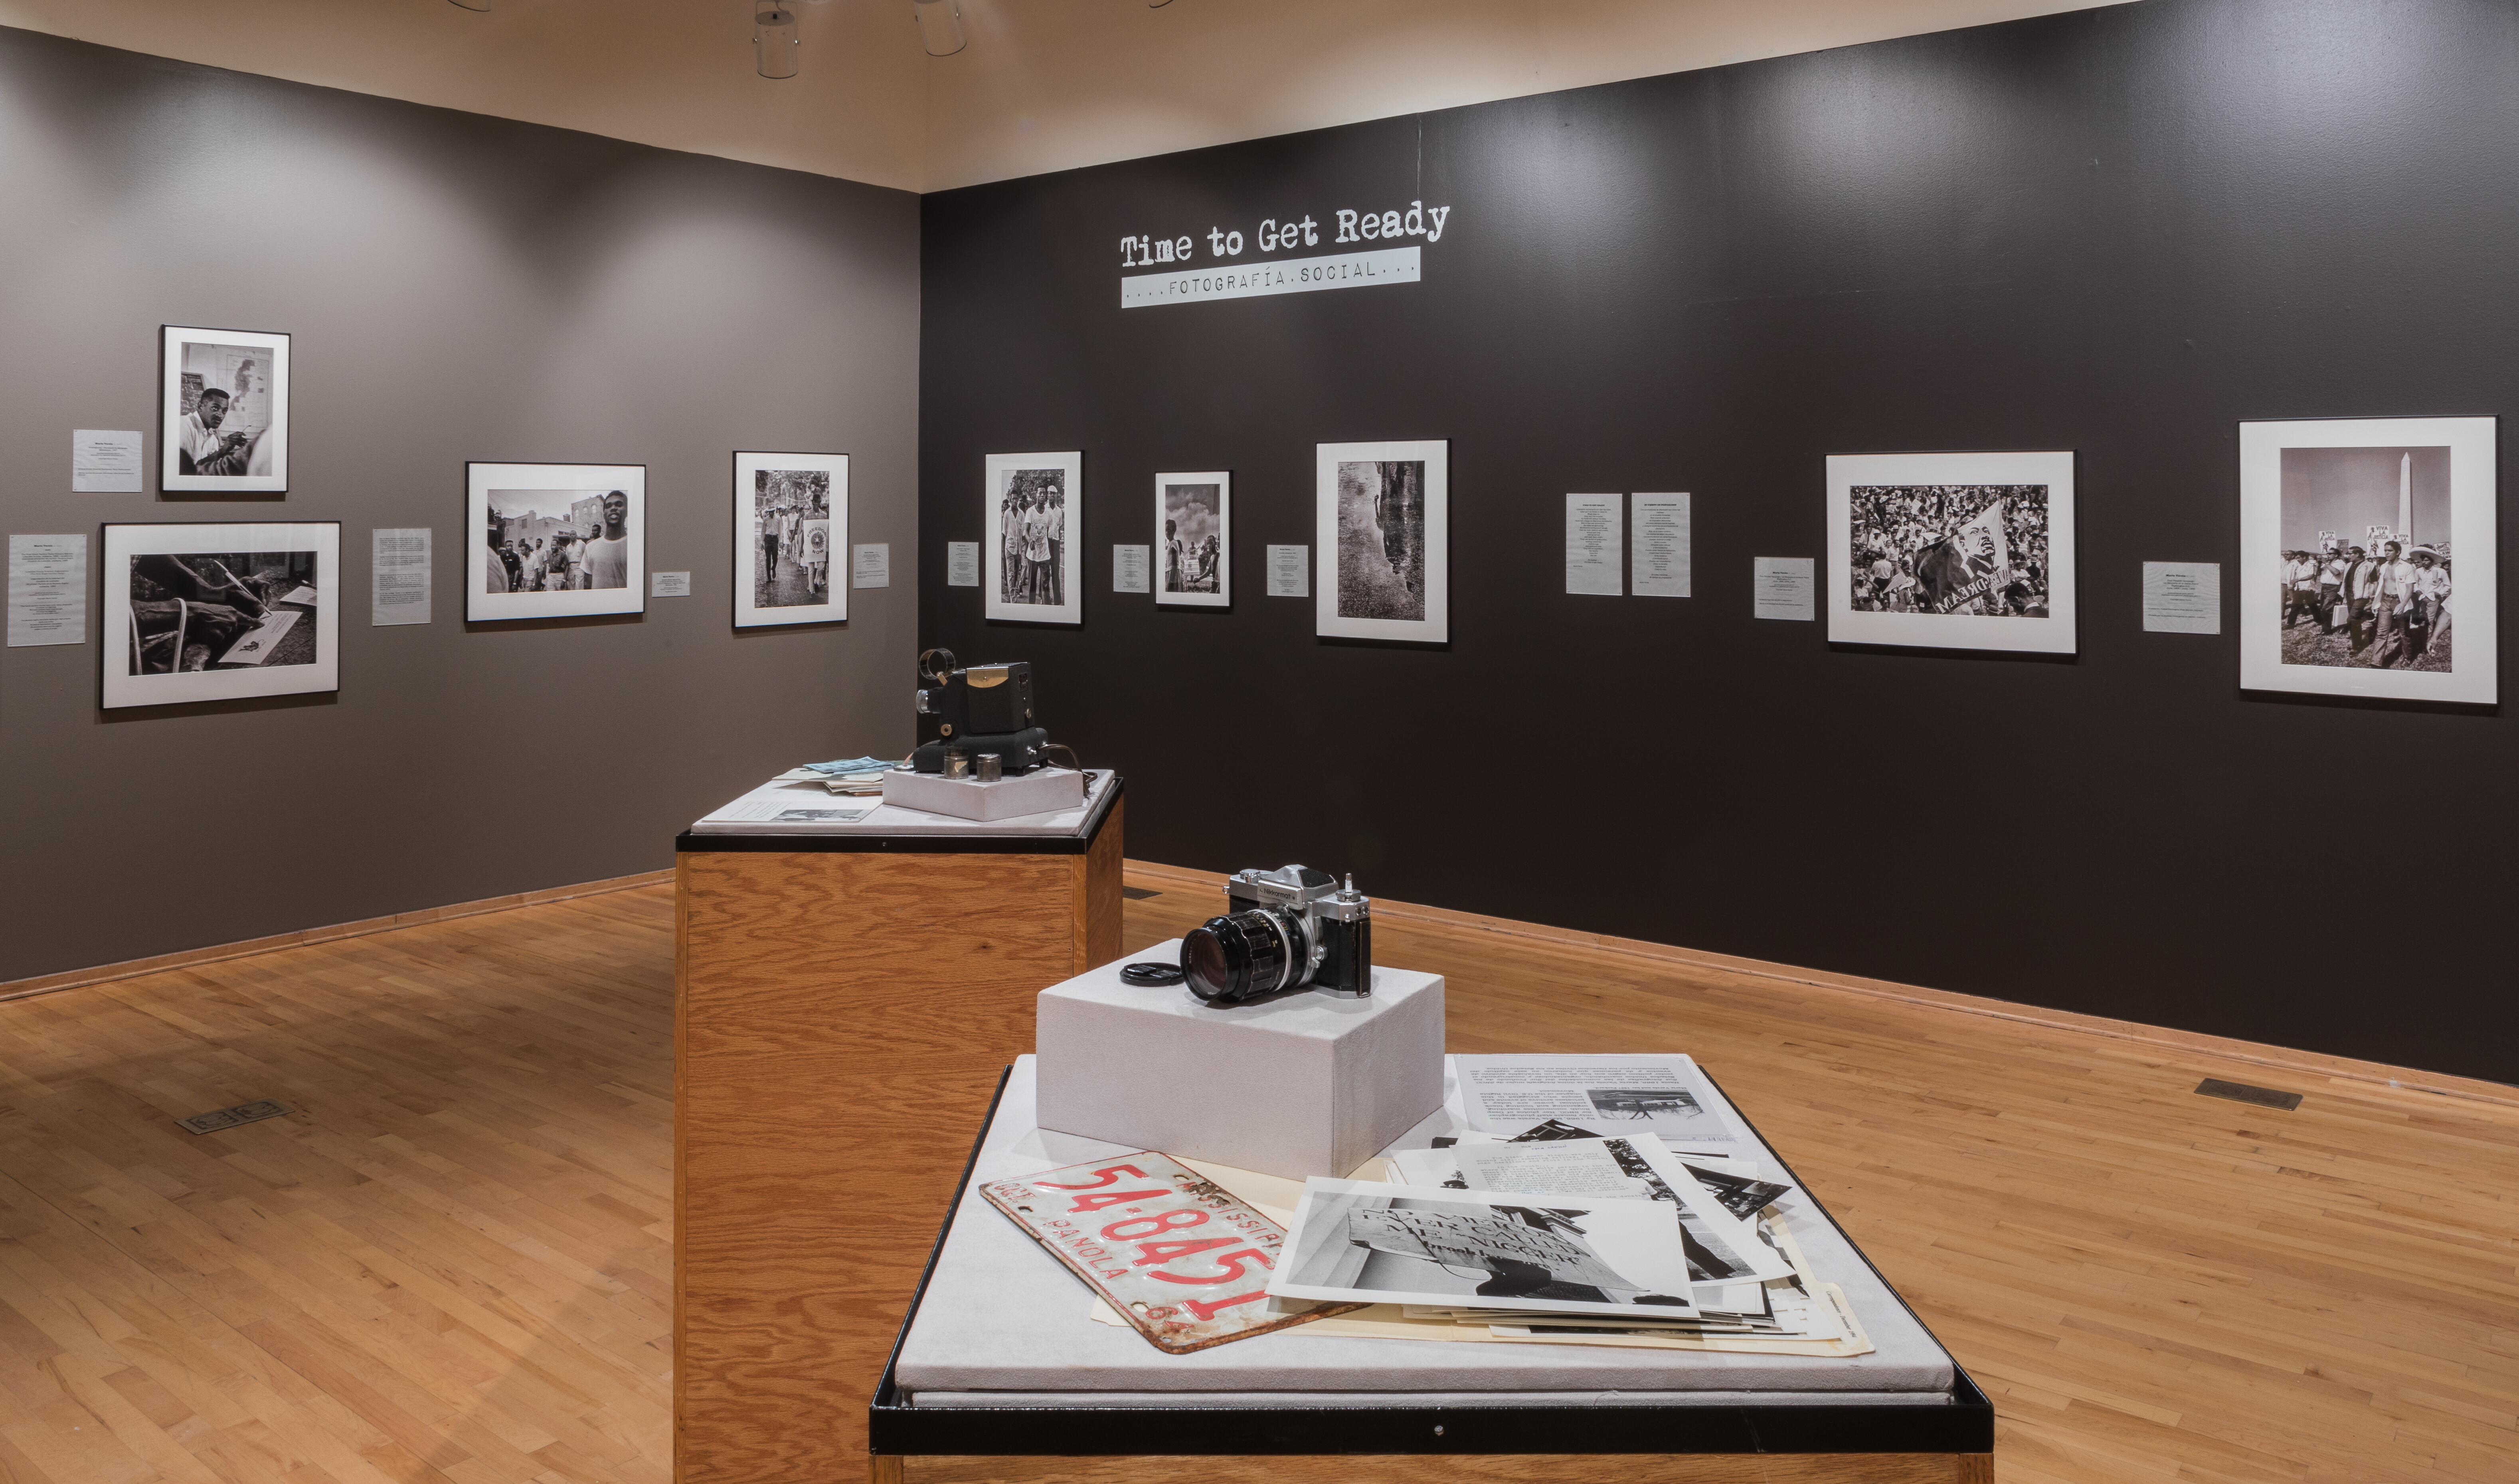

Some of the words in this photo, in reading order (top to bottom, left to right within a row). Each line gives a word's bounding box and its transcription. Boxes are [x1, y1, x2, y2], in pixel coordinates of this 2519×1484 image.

[1121, 235, 1193, 267] Time
[1207, 226, 1244, 257] to
[1259, 215, 1319, 252] Get
[1335, 200, 1450, 243] Ready
[1263, 887, 1291, 899] Nikkormat
[1043, 1219, 1129, 1280] PANOLA
[1363, 1214, 1461, 1231] EVER
[1471, 1227, 1581, 1255] CALLED
[1383, 1223, 1443, 1239] ME
